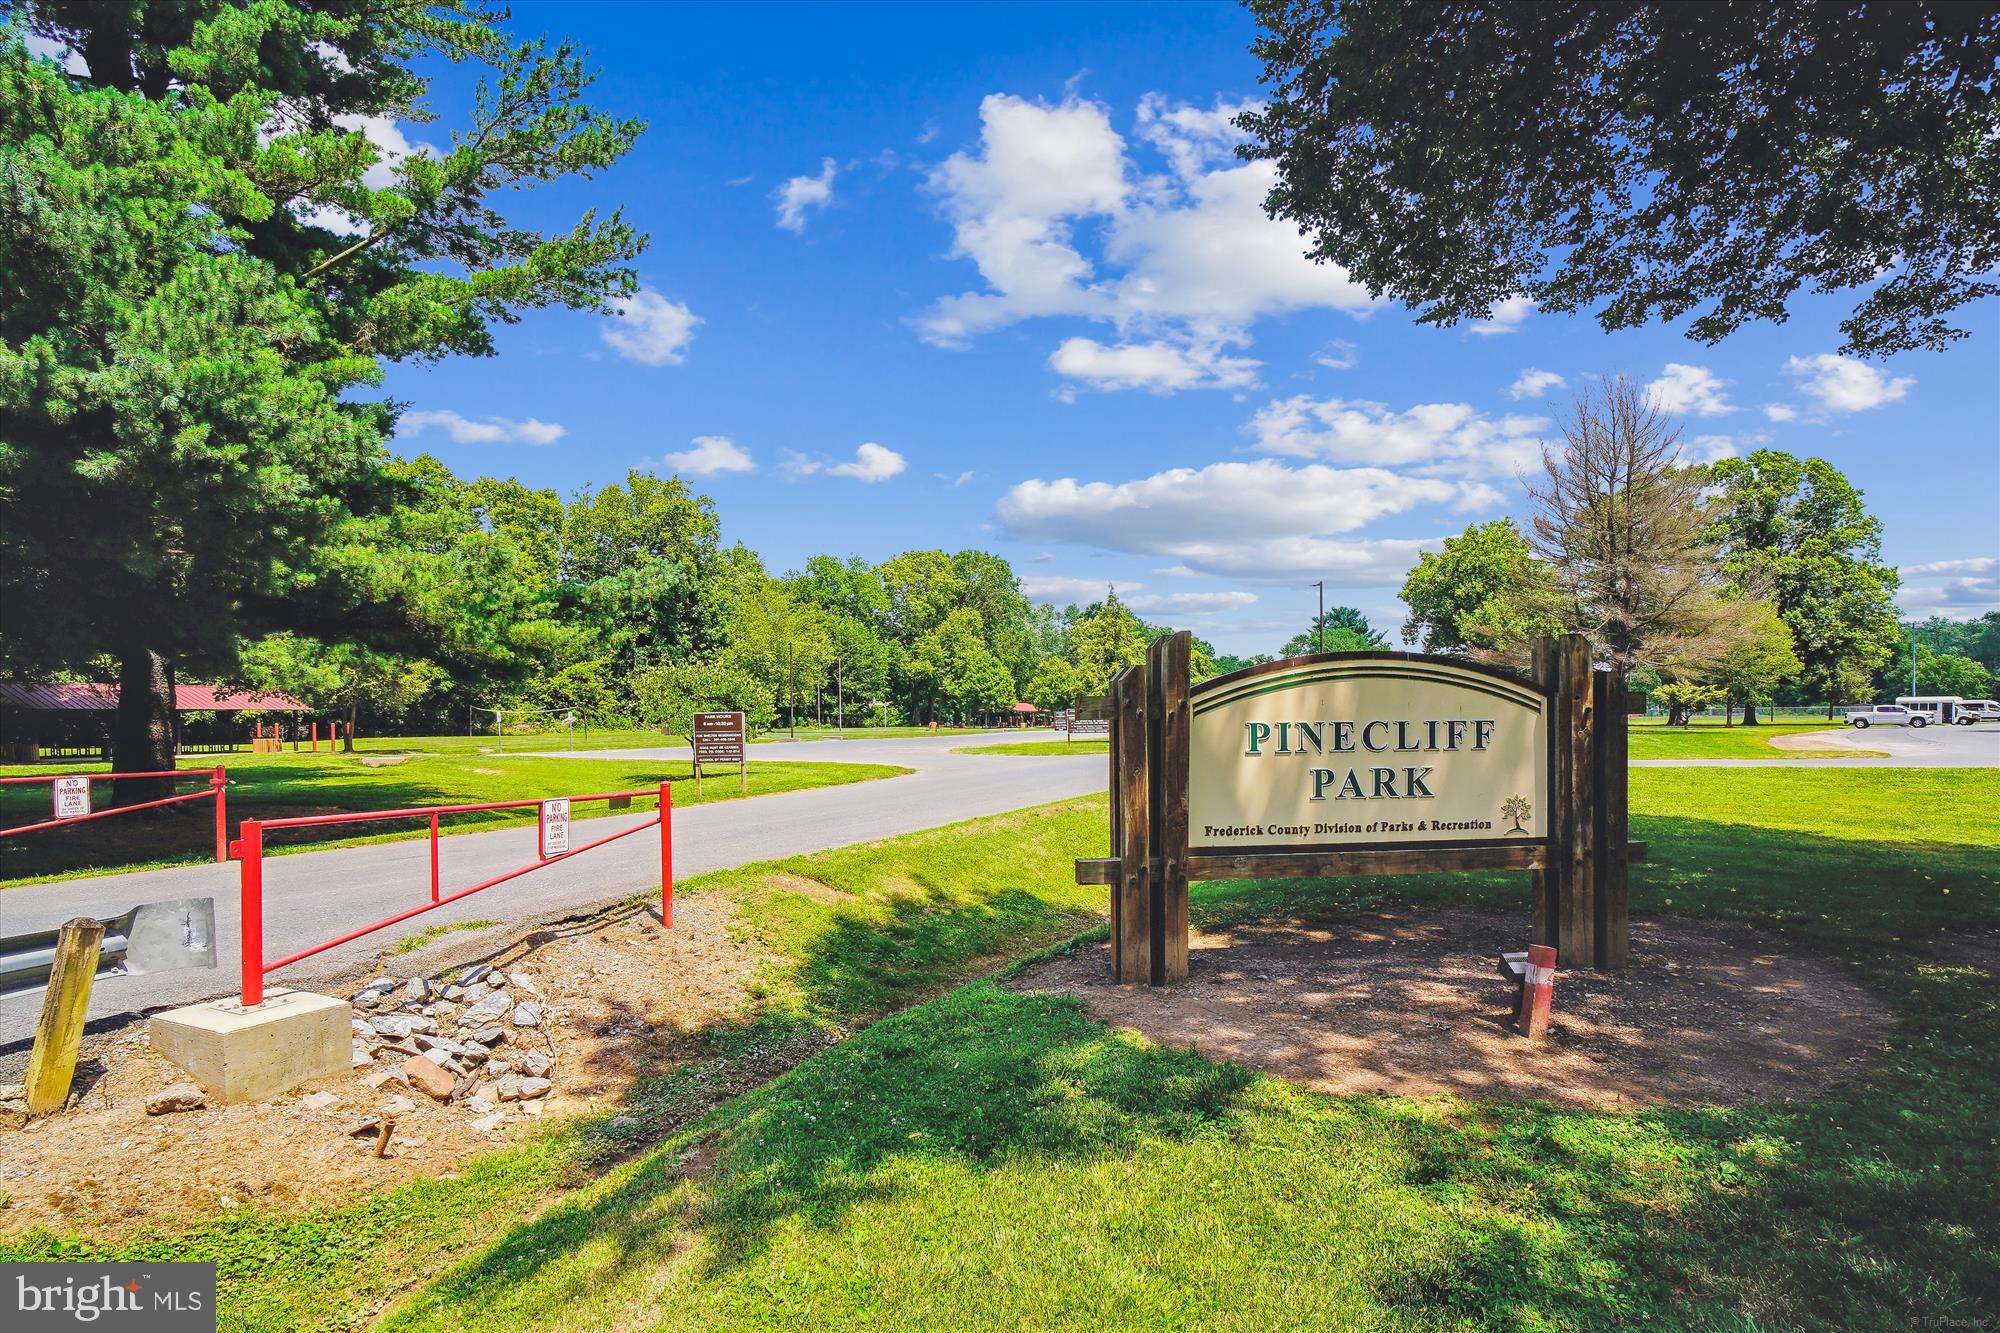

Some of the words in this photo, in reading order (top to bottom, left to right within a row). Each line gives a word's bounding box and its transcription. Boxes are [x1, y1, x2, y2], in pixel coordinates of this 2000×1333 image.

[1244, 719, 1496, 755] PINECLIFF
[1310, 767, 1435, 801] PARK
[59, 787, 86, 795] PARKING
[551, 803, 562, 813] NO
[546, 813, 568, 824] PARKING
[1204, 825, 1264, 837] Frederick
[1267, 824, 1311, 837] County
[1314, 822, 1362, 834] Division
[1366, 821, 1379, 833] of
[1380, 821, 1414, 832] Parks
[1417, 820, 1427, 831] &
[1431, 819, 1492, 831] Recreation
[549, 832, 564, 840] LANE
